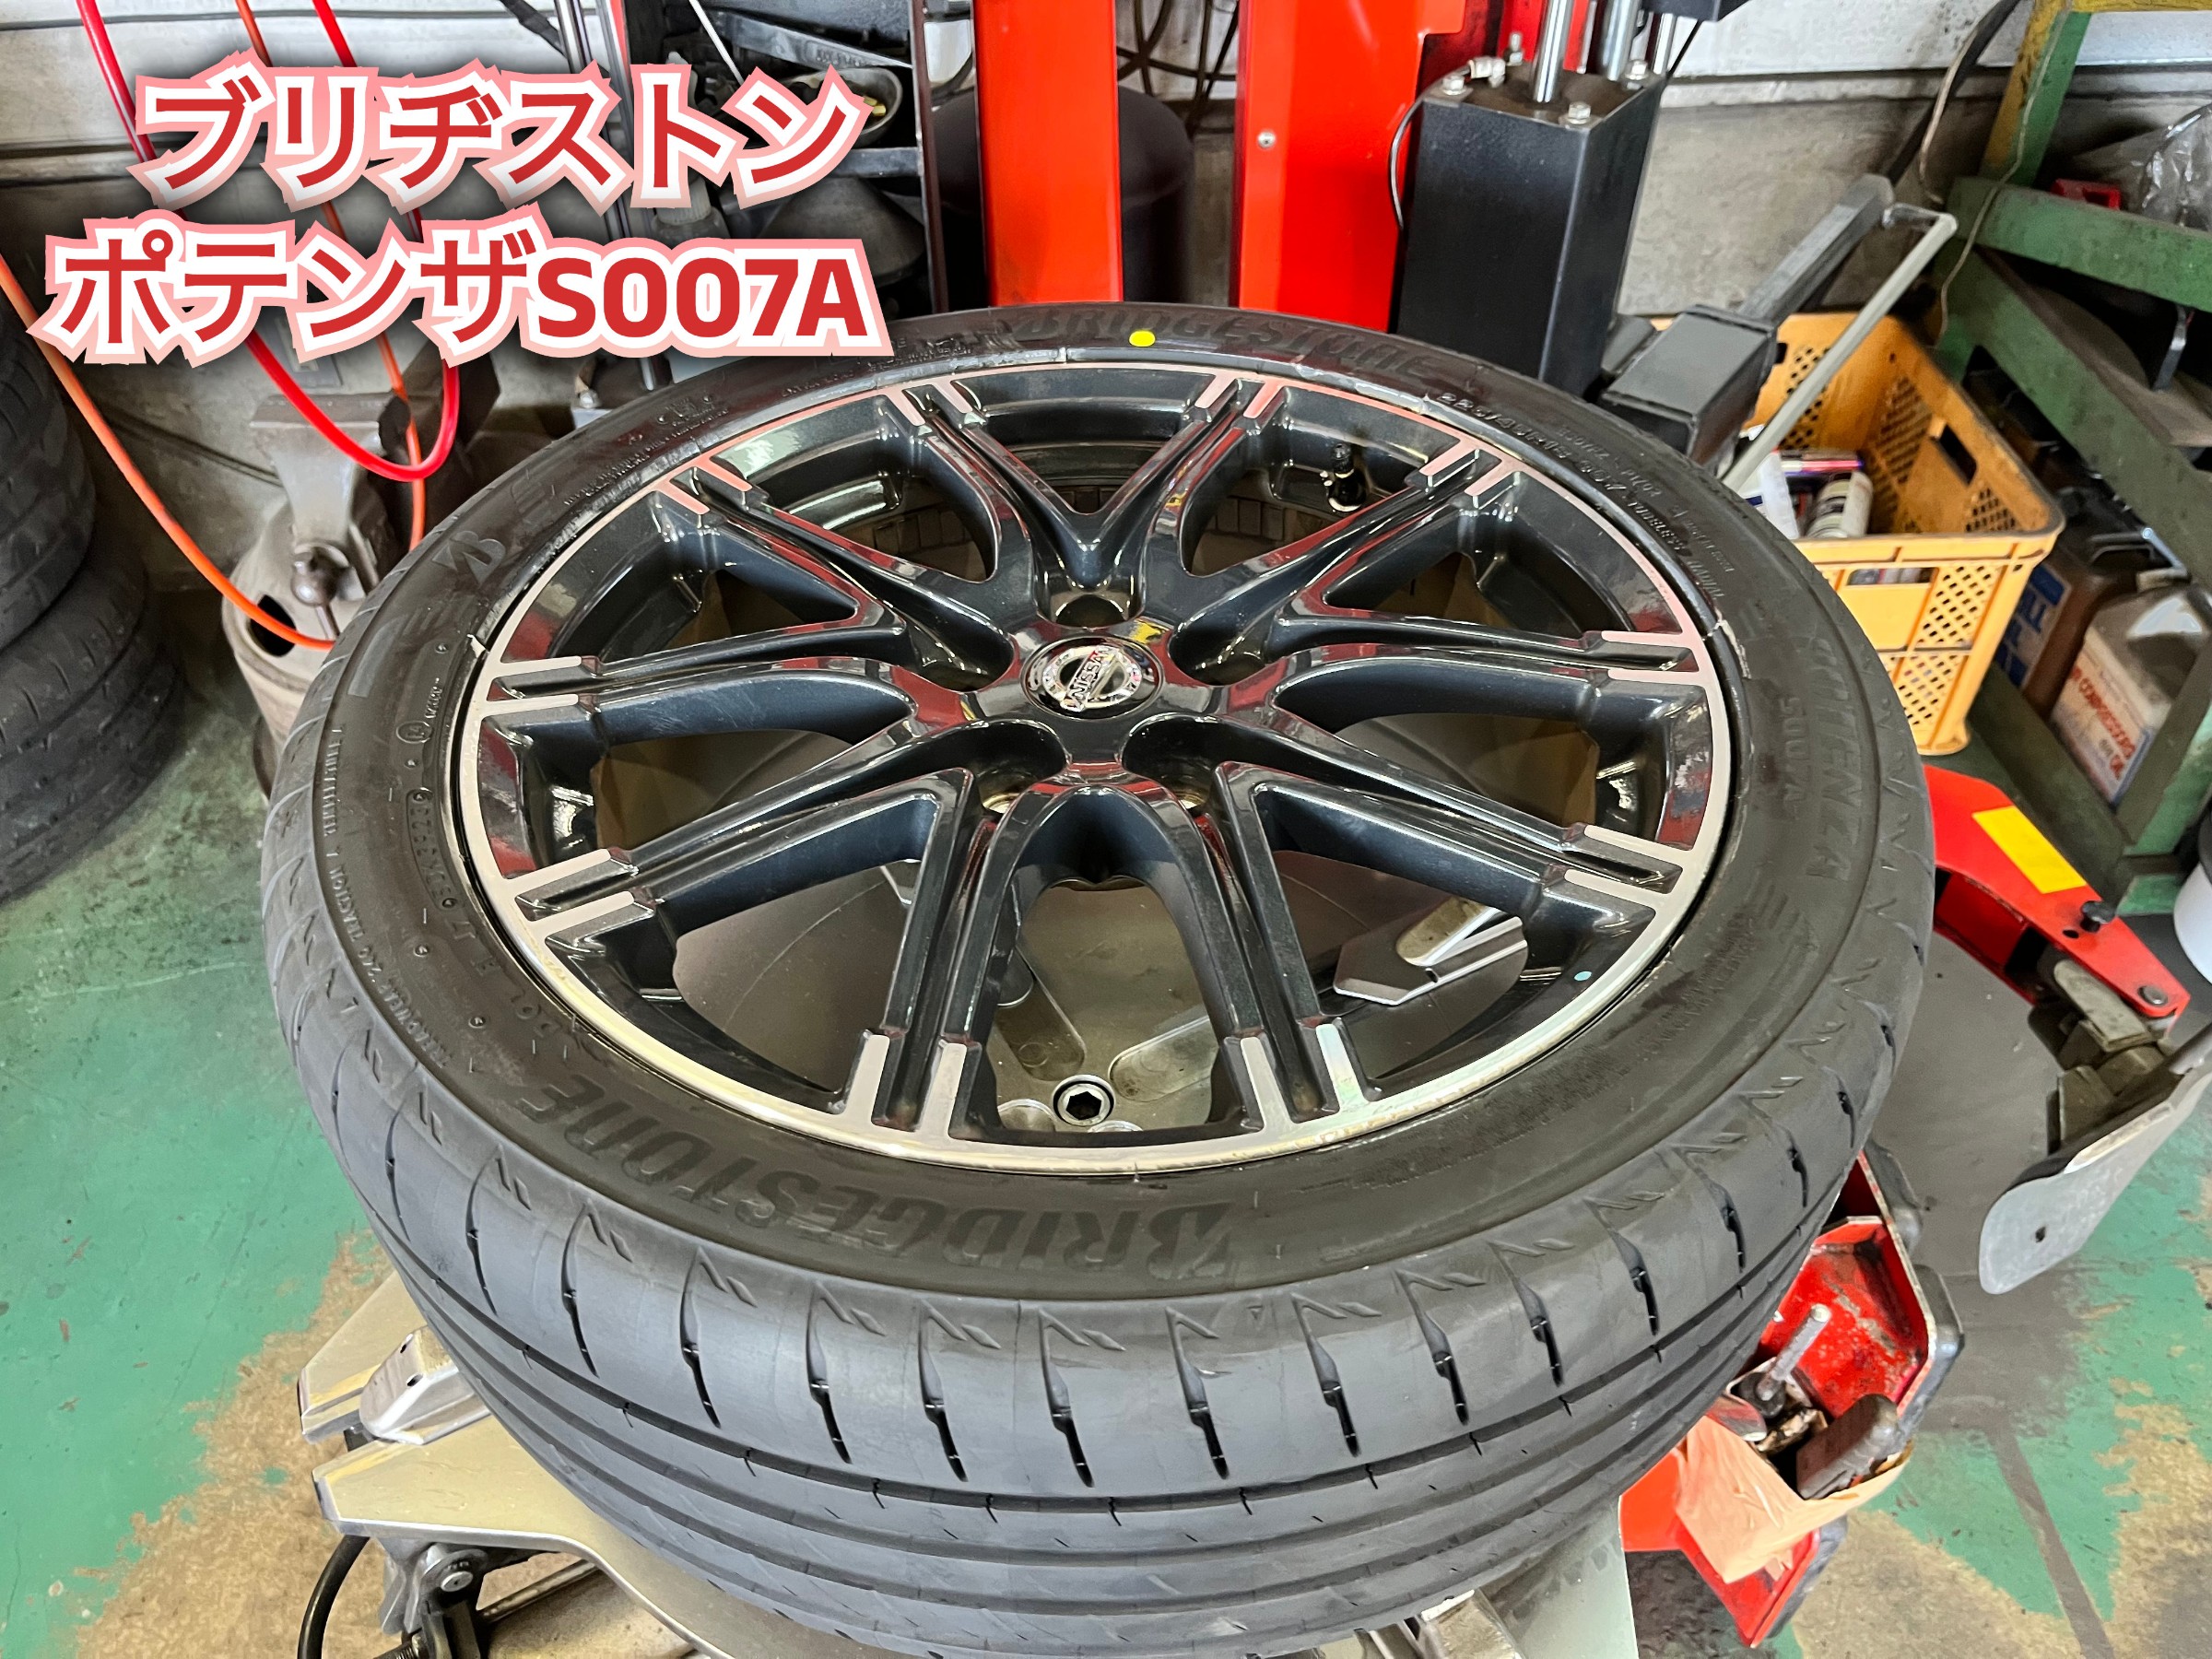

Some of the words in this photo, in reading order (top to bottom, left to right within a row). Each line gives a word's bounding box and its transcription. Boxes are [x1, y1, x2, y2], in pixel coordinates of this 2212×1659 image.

[1014, 306, 1436, 376] BRIDGESTONE
[1069, 645, 1111, 701] NISSAN
[328, 866, 365, 943] TRACTION
[377, 982, 450, 1069] TREADWEAR
[517, 1074, 1231, 1282] BRIDGESTONE
